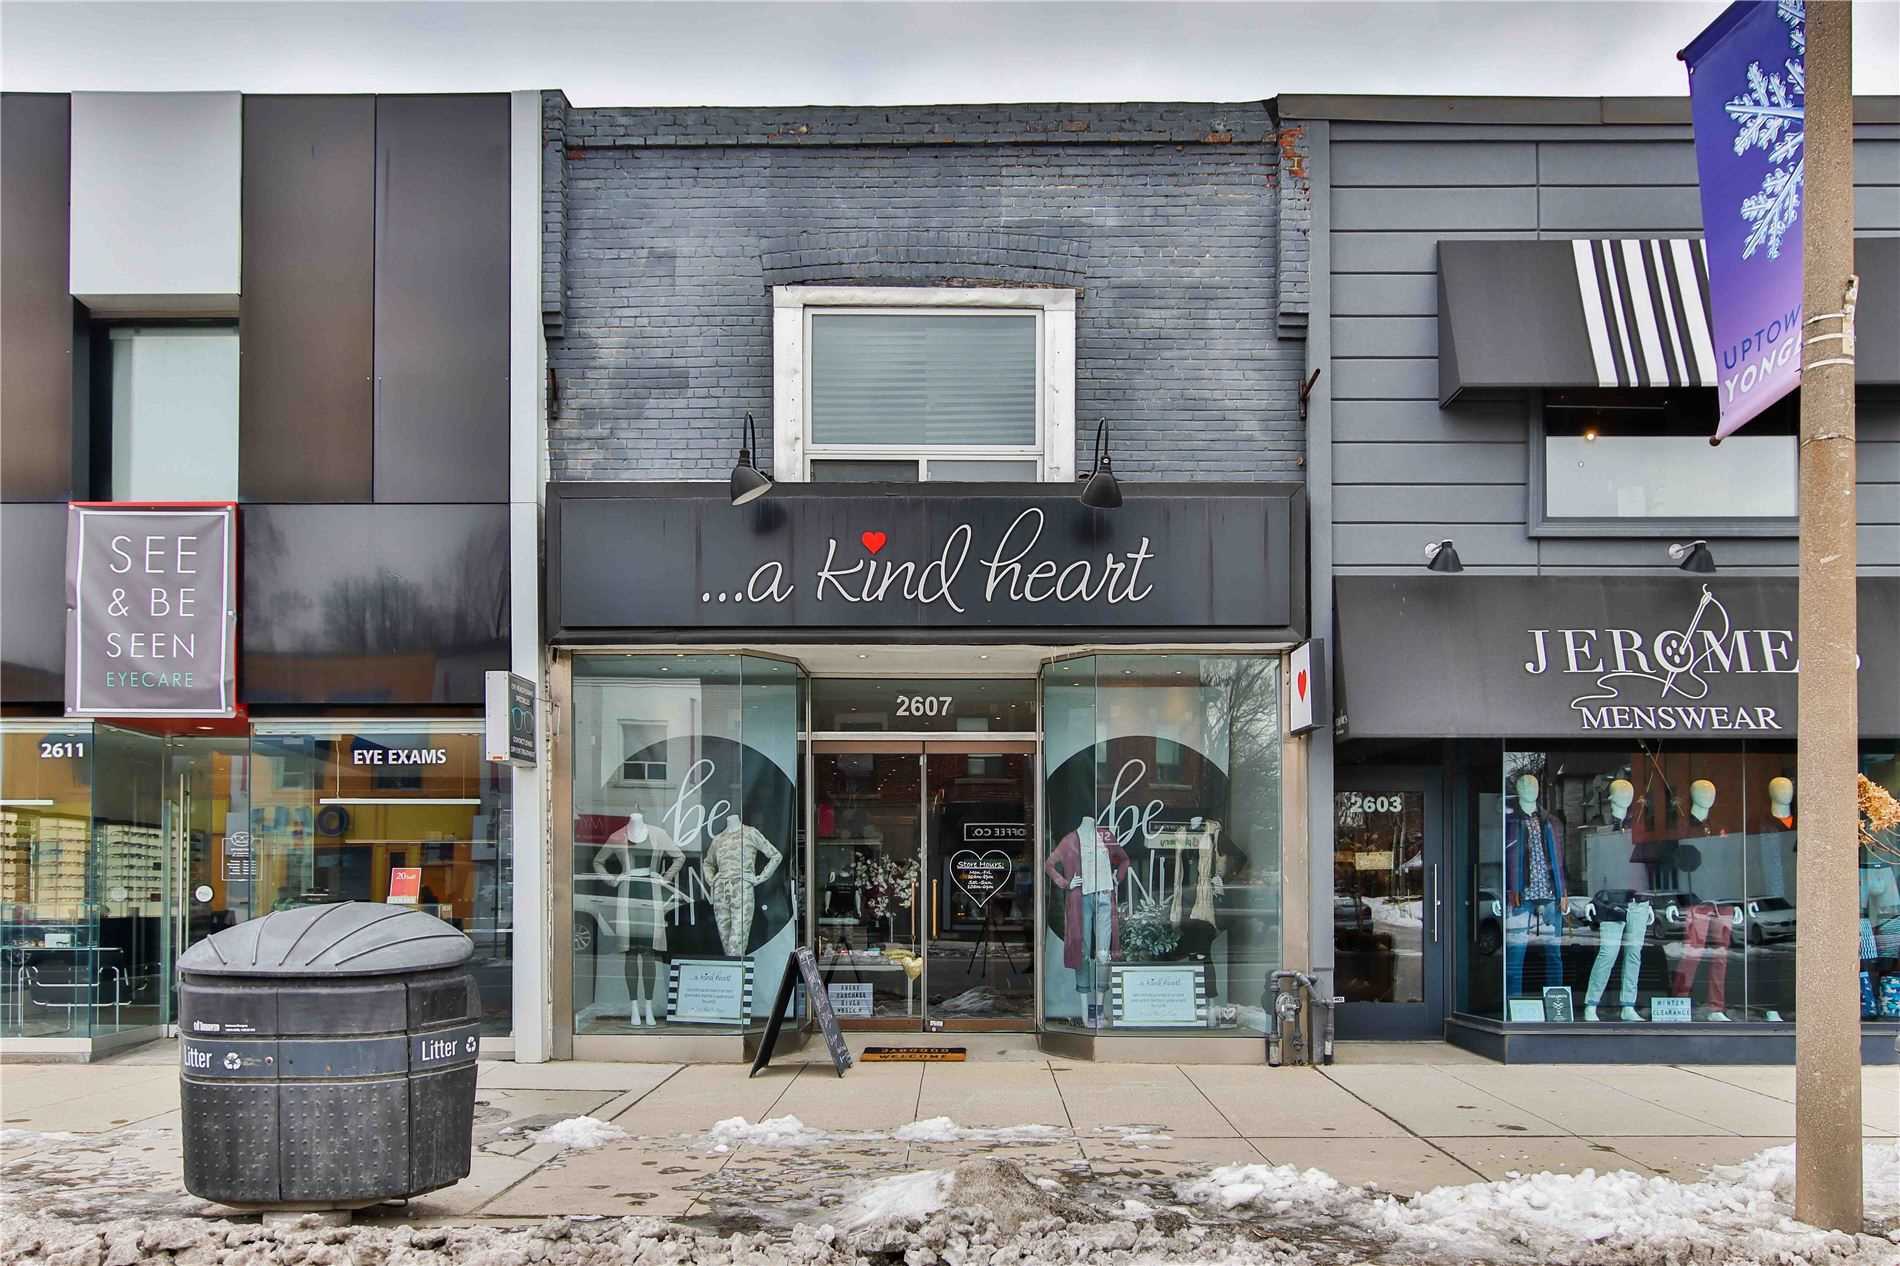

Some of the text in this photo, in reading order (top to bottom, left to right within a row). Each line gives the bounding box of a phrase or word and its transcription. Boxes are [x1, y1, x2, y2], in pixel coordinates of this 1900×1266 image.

[1724, 304, 1801, 369] UPTOW
[109, 535, 198, 574] SEE
[979, 507, 1155, 604] heart
[107, 588, 196, 617] & BE
[106, 632, 195, 659] SEEN
[1525, 629, 1861, 674] JEROME
[106, 671, 193, 688] EYECARE
[896, 695, 953, 716] 2607
[1581, 706, 1783, 730] MENSWEAR
[40, 742, 84, 758] 2611
[353, 749, 447, 765] EYE EXAMS
[662, 758, 731, 848] be
[1097, 758, 1165, 848] be
[1350, 796, 1403, 813] 2603
[183, 1044, 213, 1069] Litter
[422, 1040, 458, 1061] Litter
